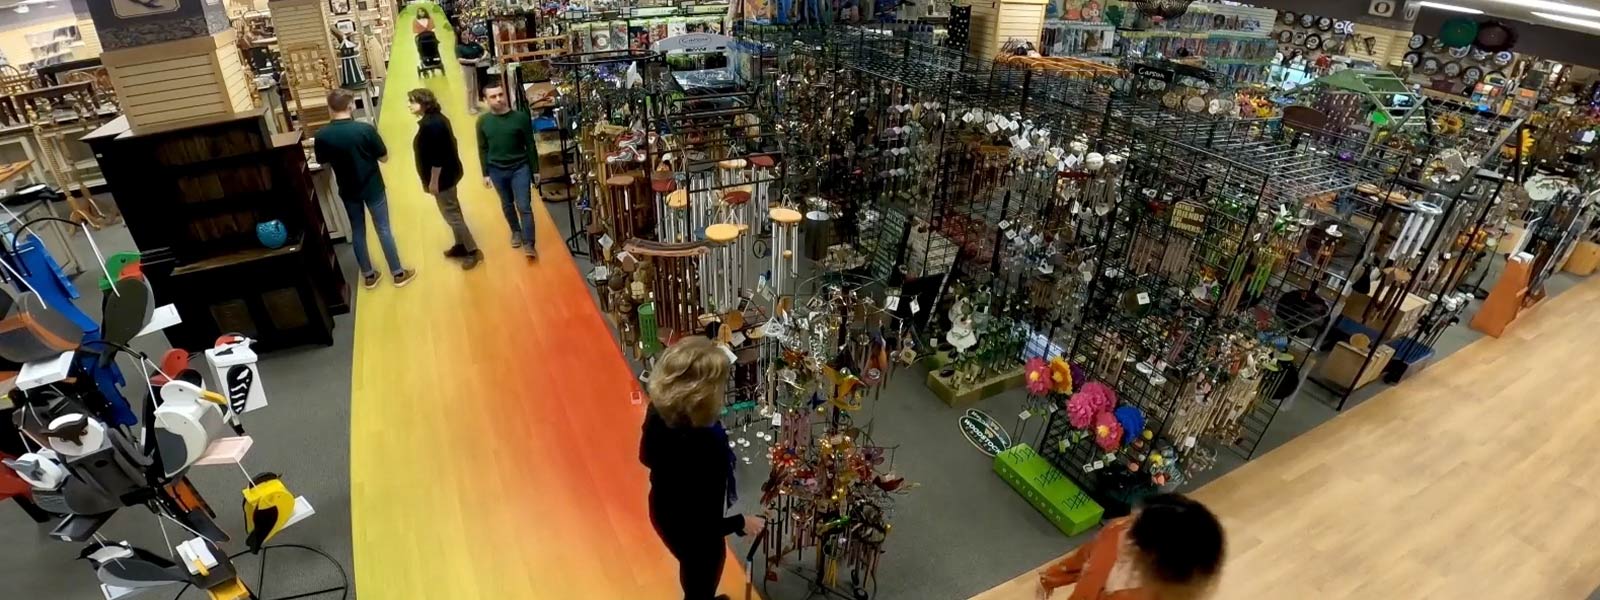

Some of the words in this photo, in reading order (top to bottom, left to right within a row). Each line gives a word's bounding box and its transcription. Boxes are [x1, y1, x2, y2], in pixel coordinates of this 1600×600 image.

[1138, 67, 1165, 79] Carson
[1173, 208, 1205, 223] FRIENDS
[1169, 220, 1201, 233] FLOWERS
[964, 418, 1002, 455] WOODSTOCK
